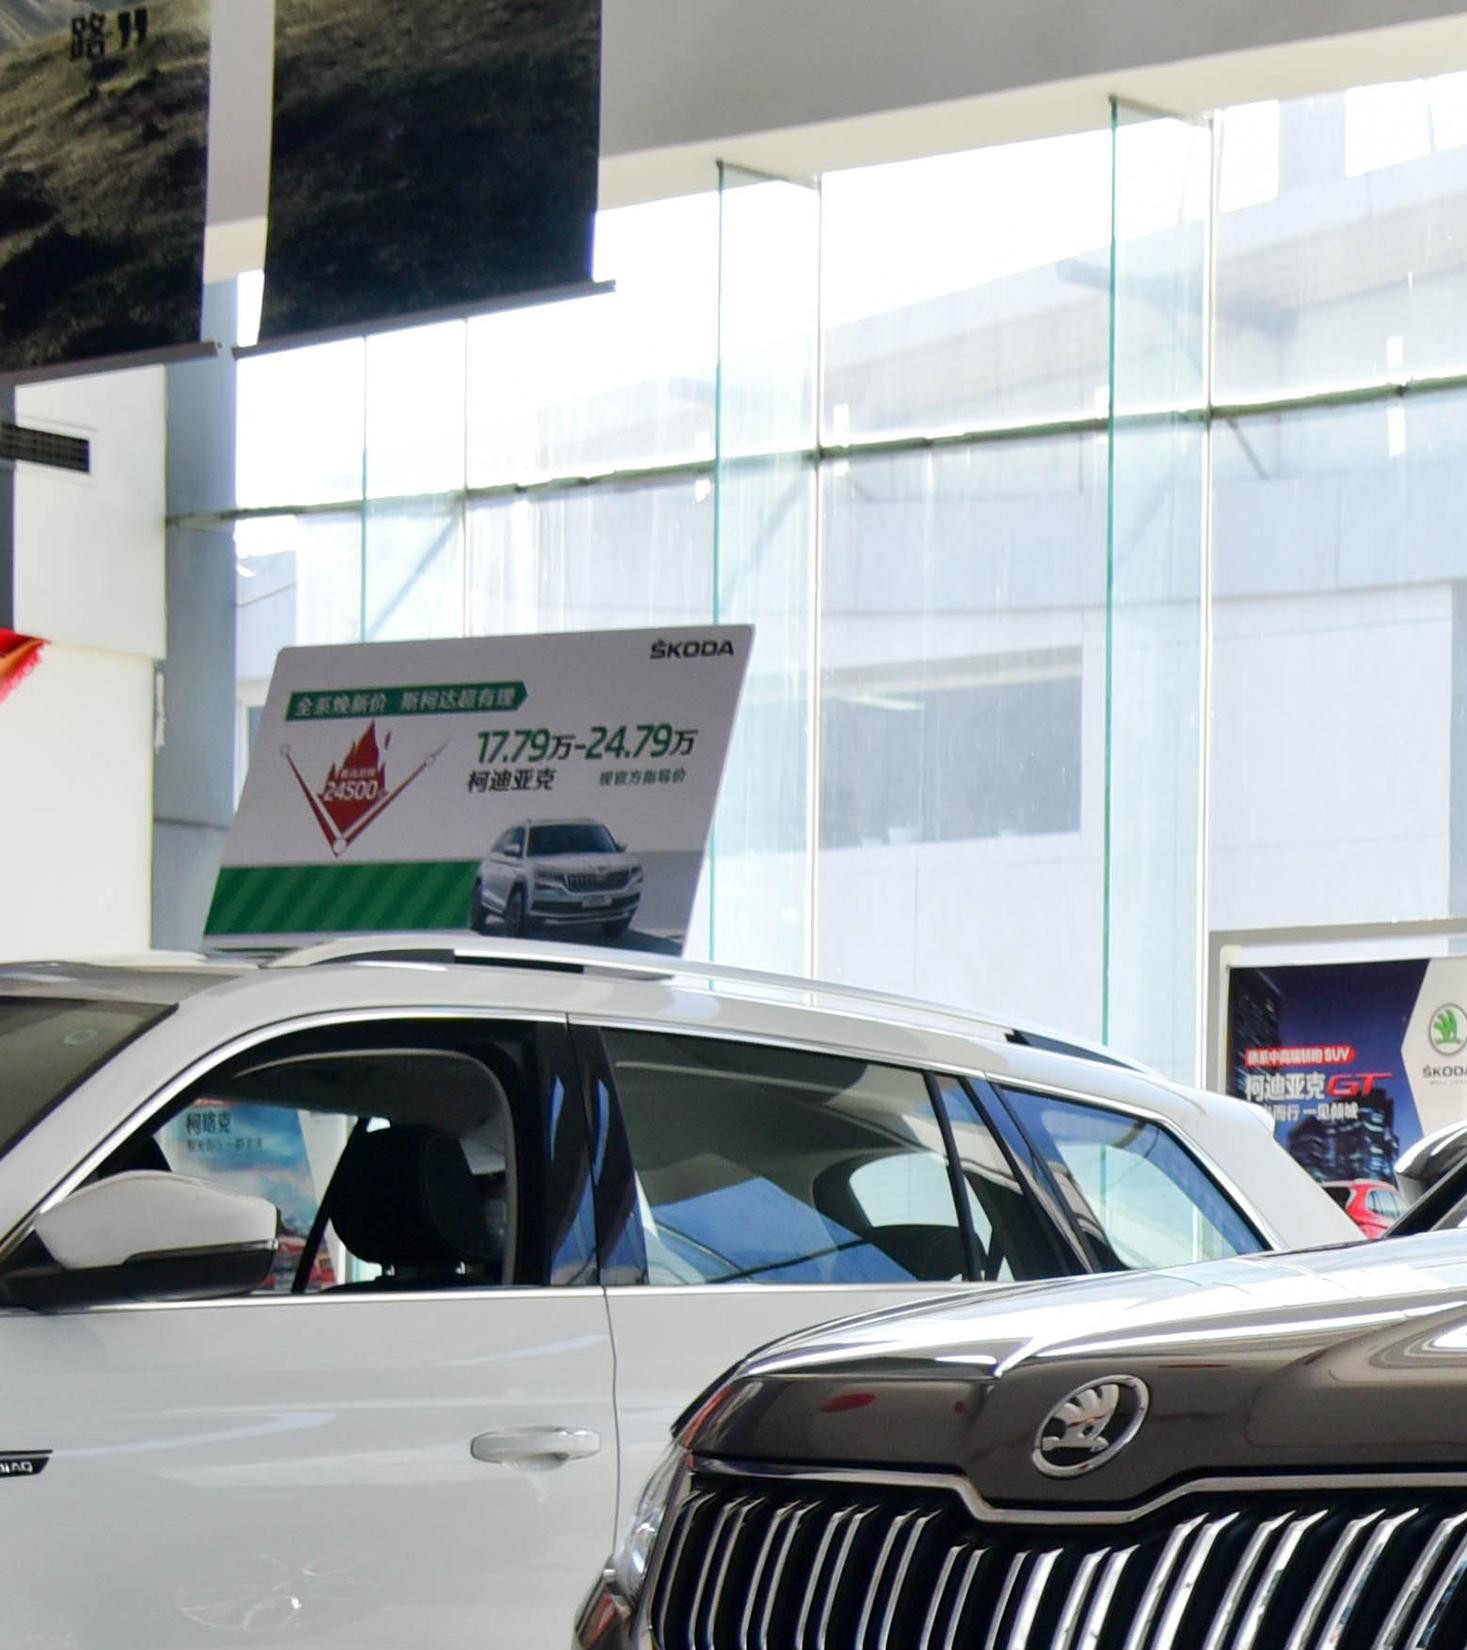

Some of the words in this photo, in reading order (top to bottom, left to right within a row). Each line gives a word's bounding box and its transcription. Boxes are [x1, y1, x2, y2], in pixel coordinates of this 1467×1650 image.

[650, 639, 734, 659] ŠKODA
[324, 779, 379, 801] 24500
[467, 768, 556, 793] 柯迪亚克
[1324, 1047, 1350, 1062] SUV
[1328, 1072, 1392, 1097] GT
